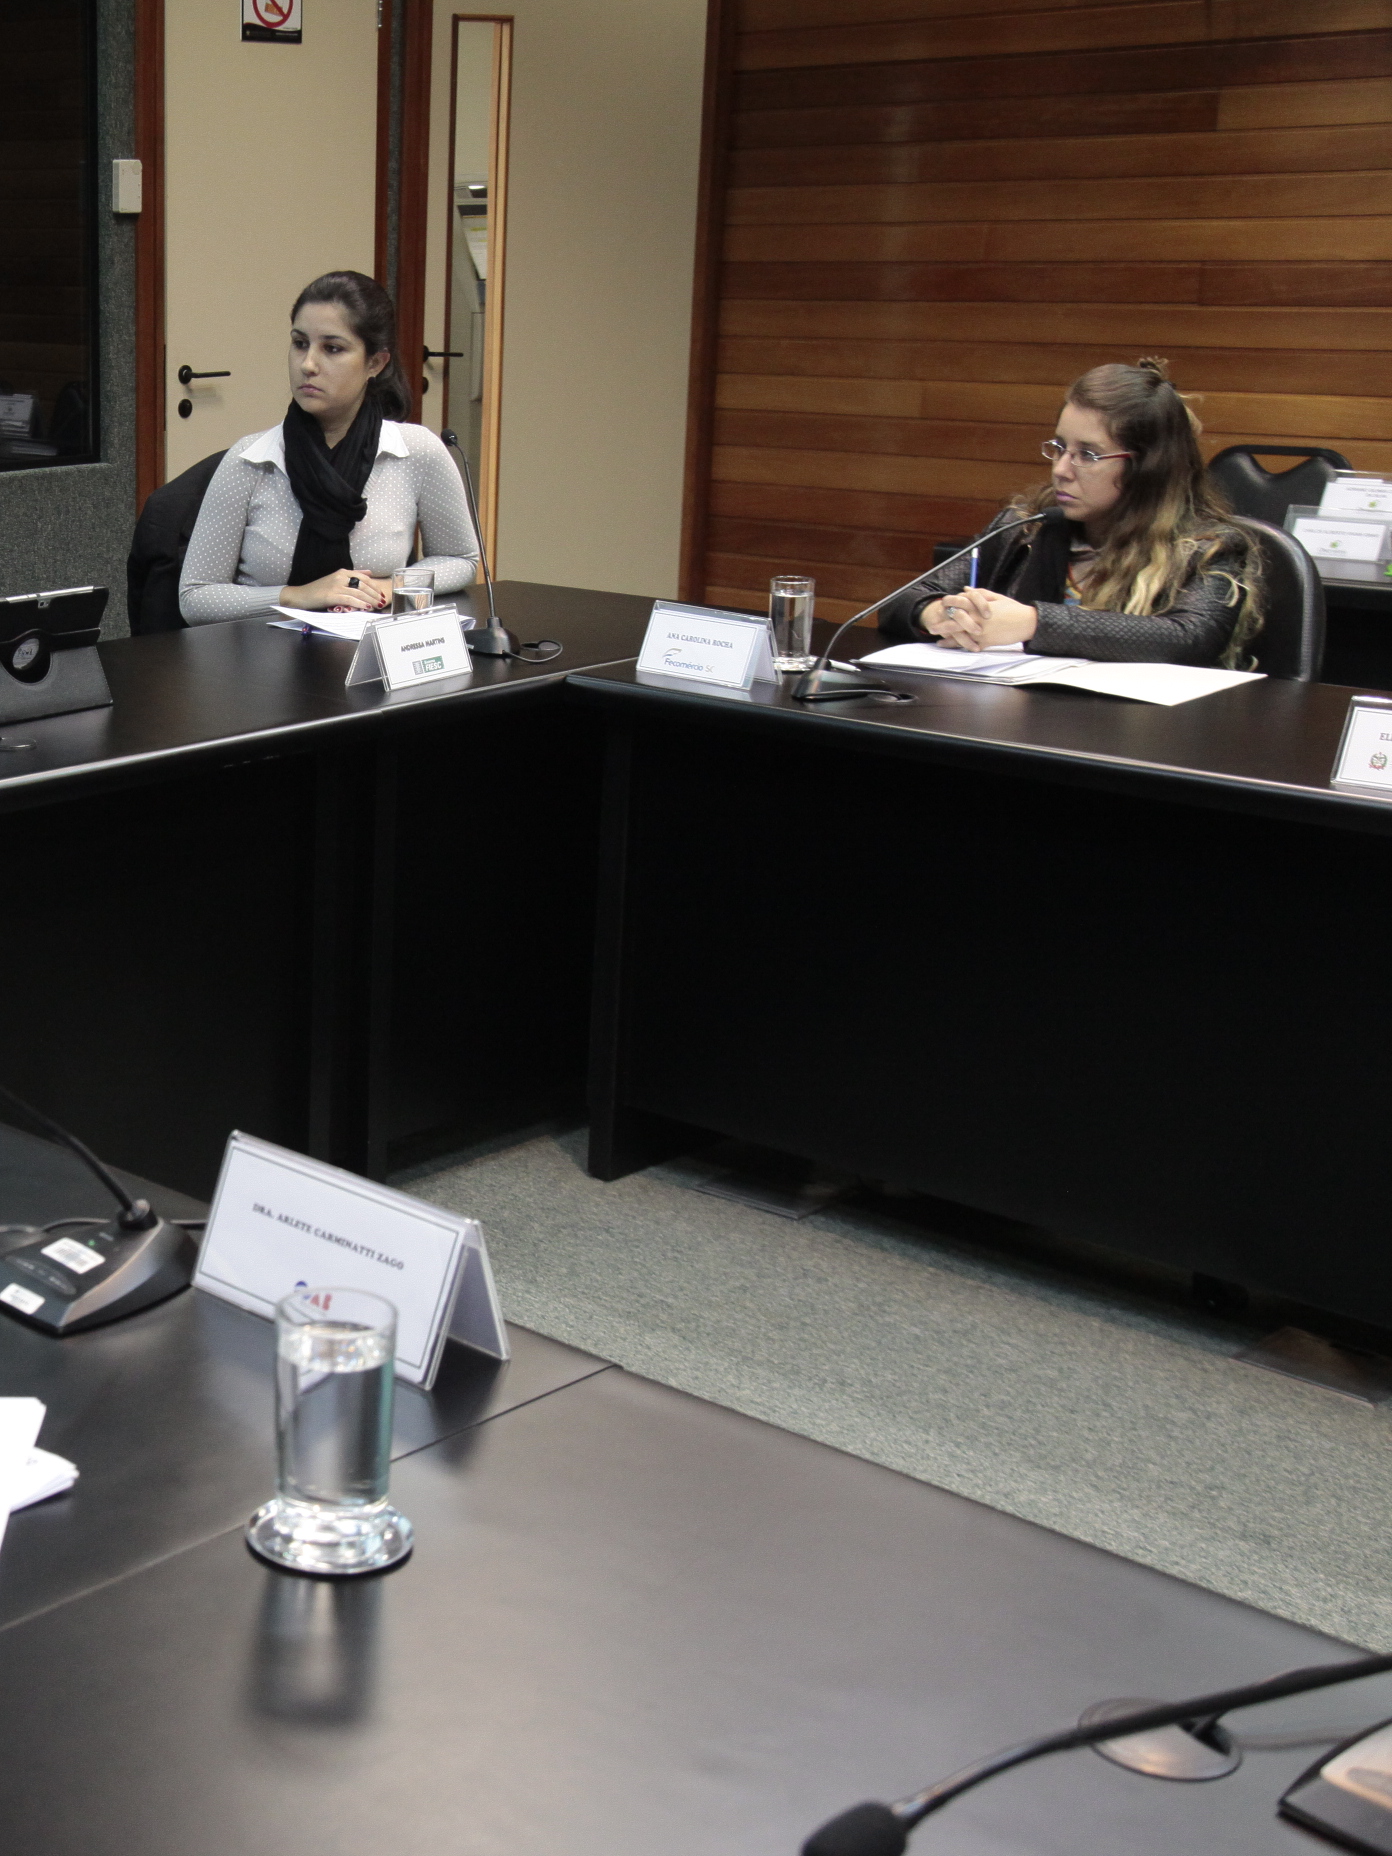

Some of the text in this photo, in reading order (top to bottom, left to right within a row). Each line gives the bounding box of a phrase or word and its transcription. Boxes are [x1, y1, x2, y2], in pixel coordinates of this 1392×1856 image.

[681, 634, 711, 645] CAROLINA
[253, 1203, 405, 1271] DRA. ARLETE CARMINATTI ZAGO
